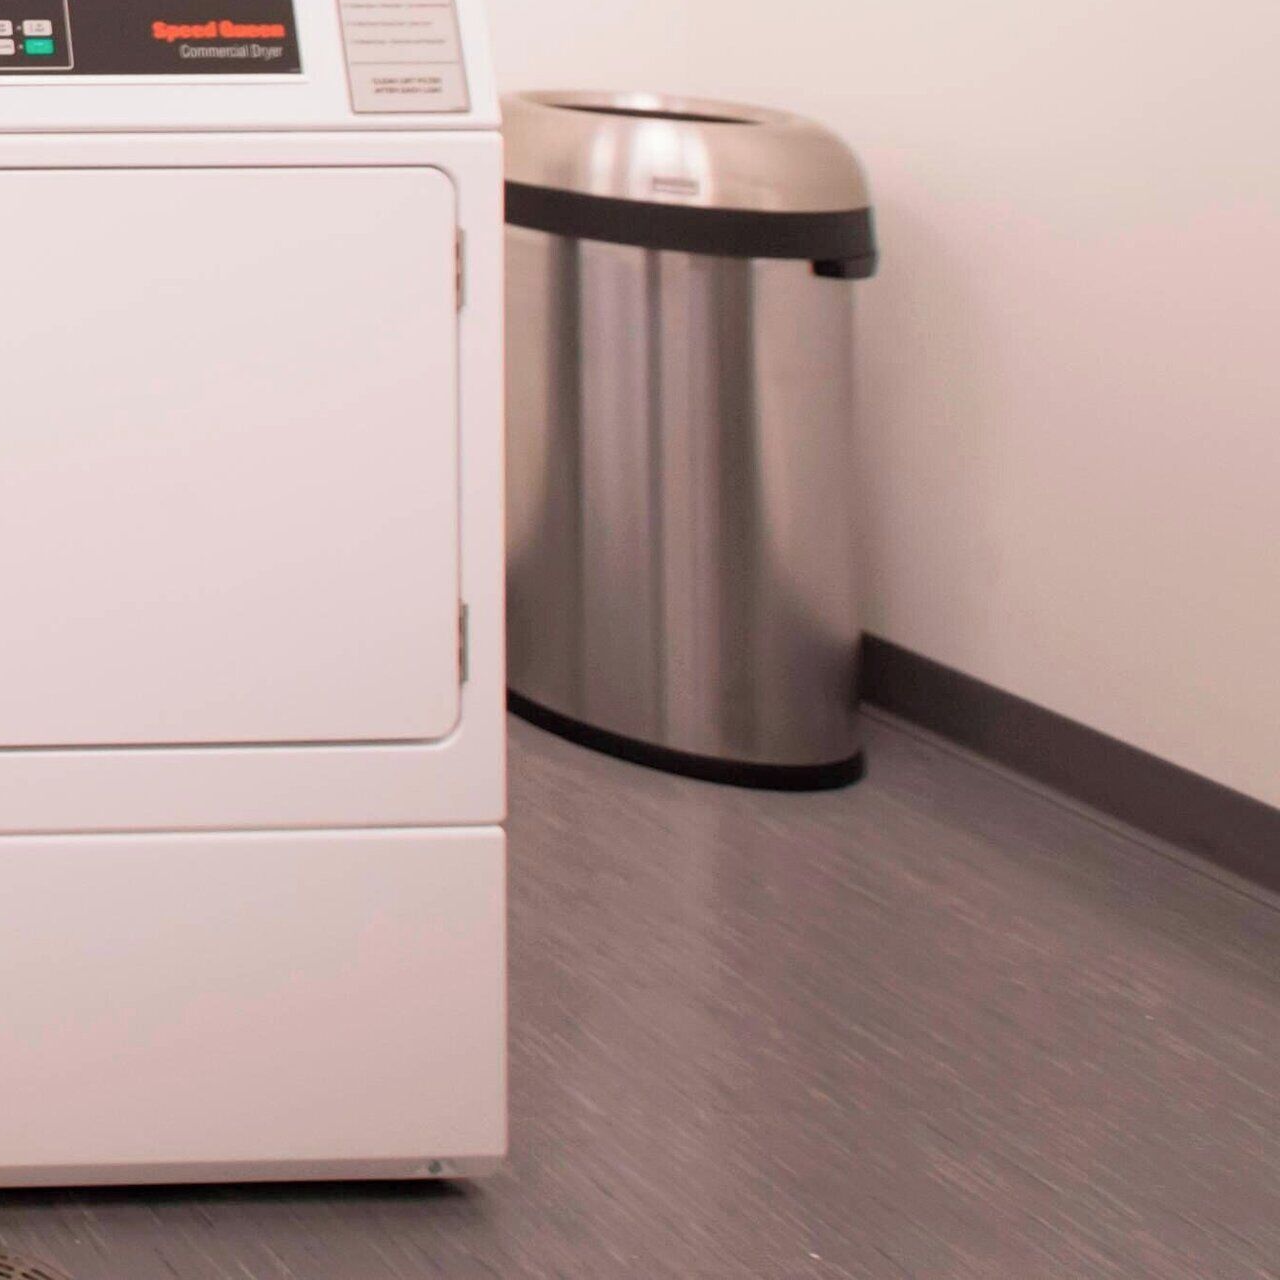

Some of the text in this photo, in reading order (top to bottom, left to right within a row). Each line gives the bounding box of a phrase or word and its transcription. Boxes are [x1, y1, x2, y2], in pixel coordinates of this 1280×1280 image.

[152, 20, 286, 42] Speed Queen
[180, 43, 283, 60] Commercial Dryer
